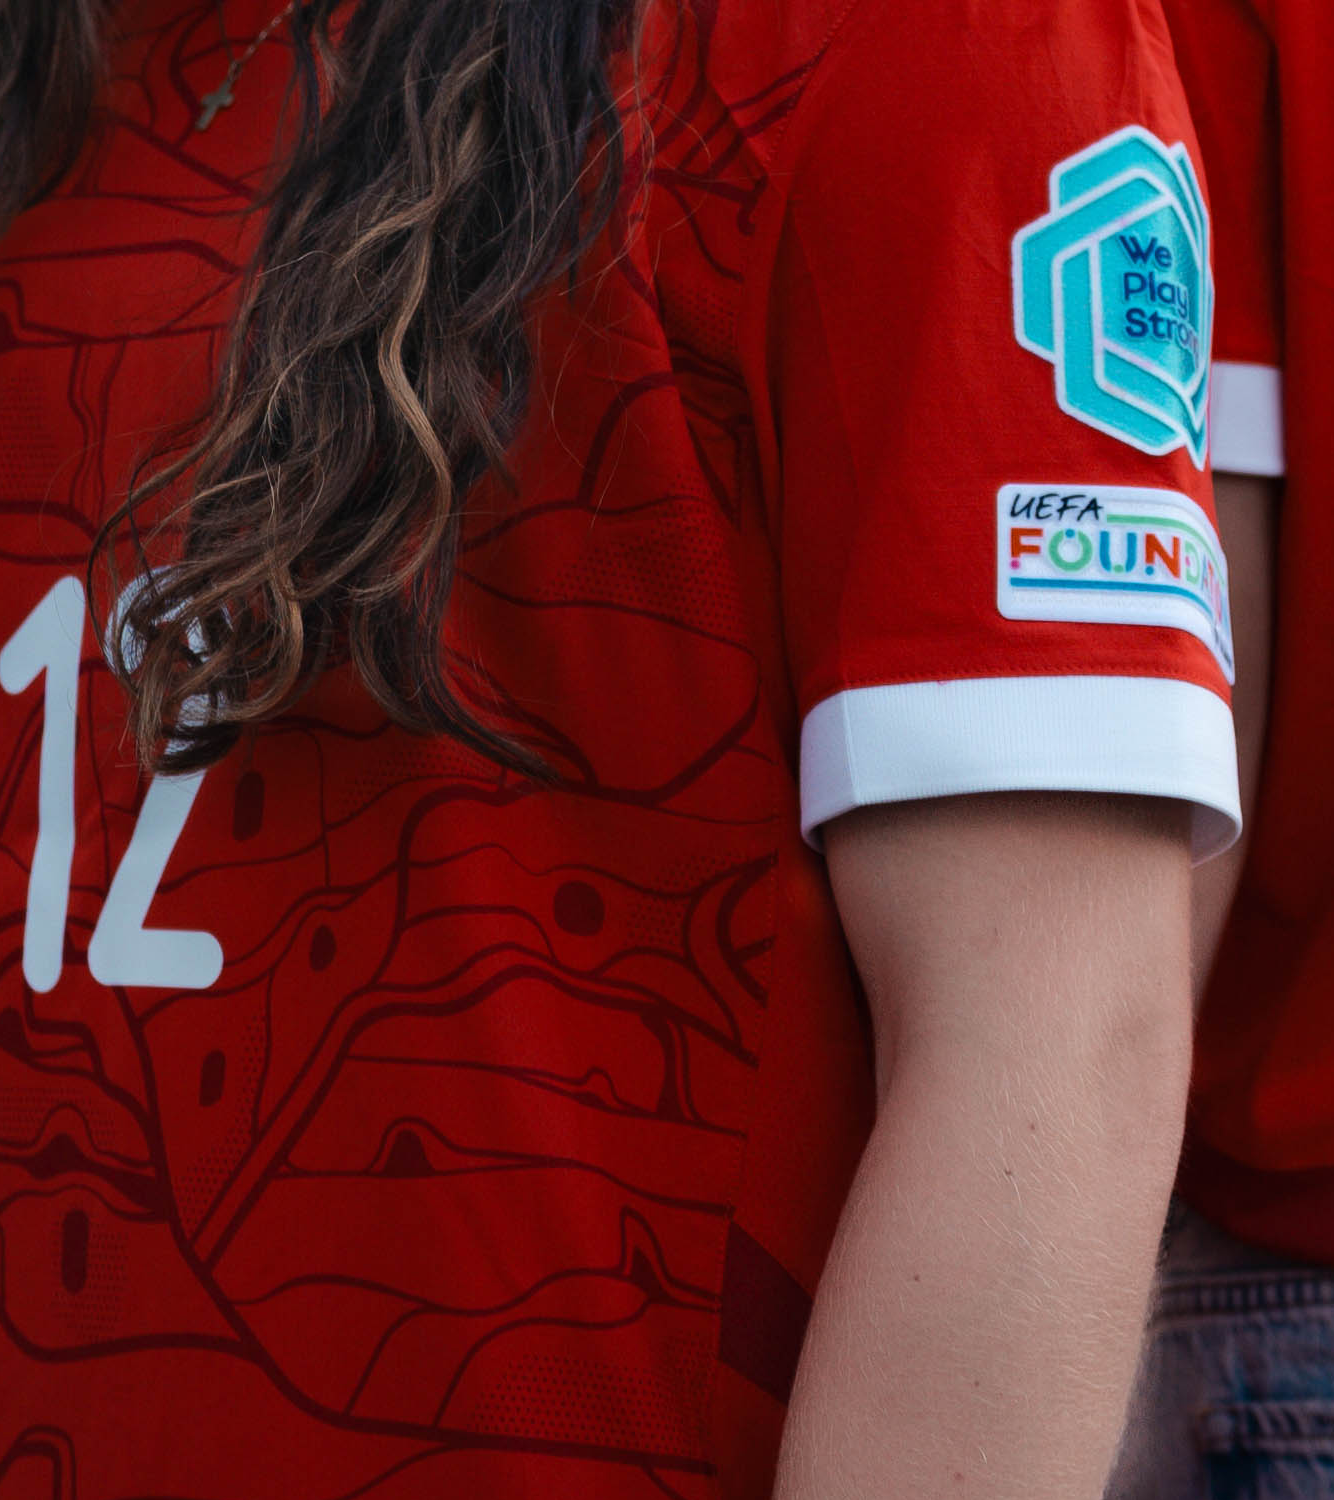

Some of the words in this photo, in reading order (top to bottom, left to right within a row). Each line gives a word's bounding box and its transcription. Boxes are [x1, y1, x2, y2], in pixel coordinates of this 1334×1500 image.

[1119, 235, 1172, 268] We
[1123, 271, 1188, 319] Play
[1010, 493, 1103, 521] UEFA
